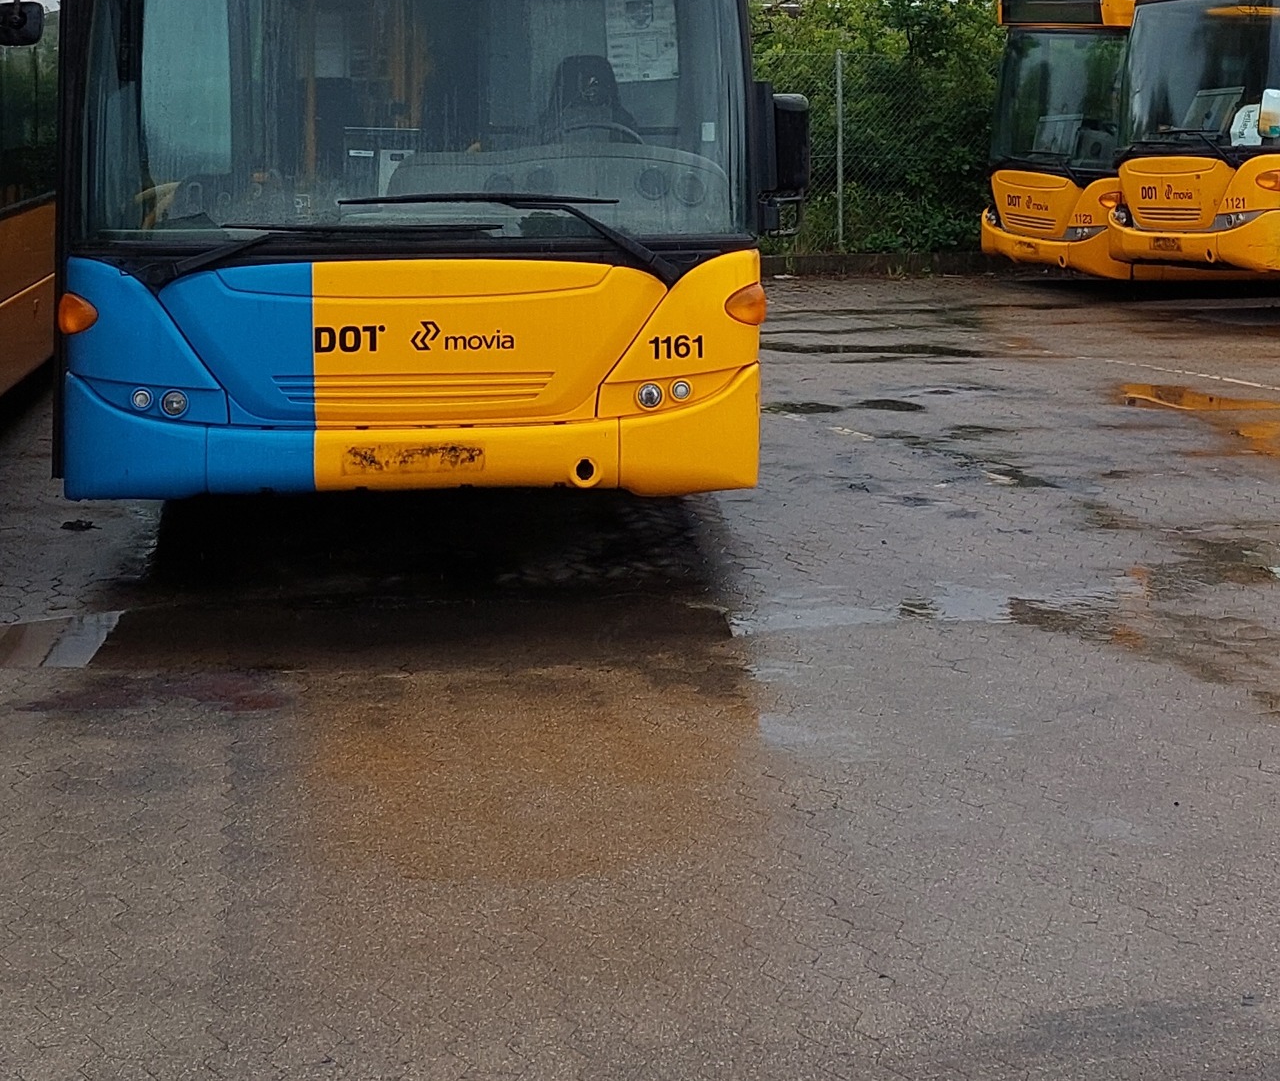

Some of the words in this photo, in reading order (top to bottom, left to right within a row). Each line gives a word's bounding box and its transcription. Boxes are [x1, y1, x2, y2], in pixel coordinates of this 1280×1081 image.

[1173, 188, 1193, 200] movia
[1007, 194, 1021, 208] DOT
[1225, 197, 1246, 209] 1121
[1074, 213, 1093, 224] 1123
[314, 325, 385, 353] DOT
[444, 329, 515, 351] movia
[648, 335, 705, 359] 1161
